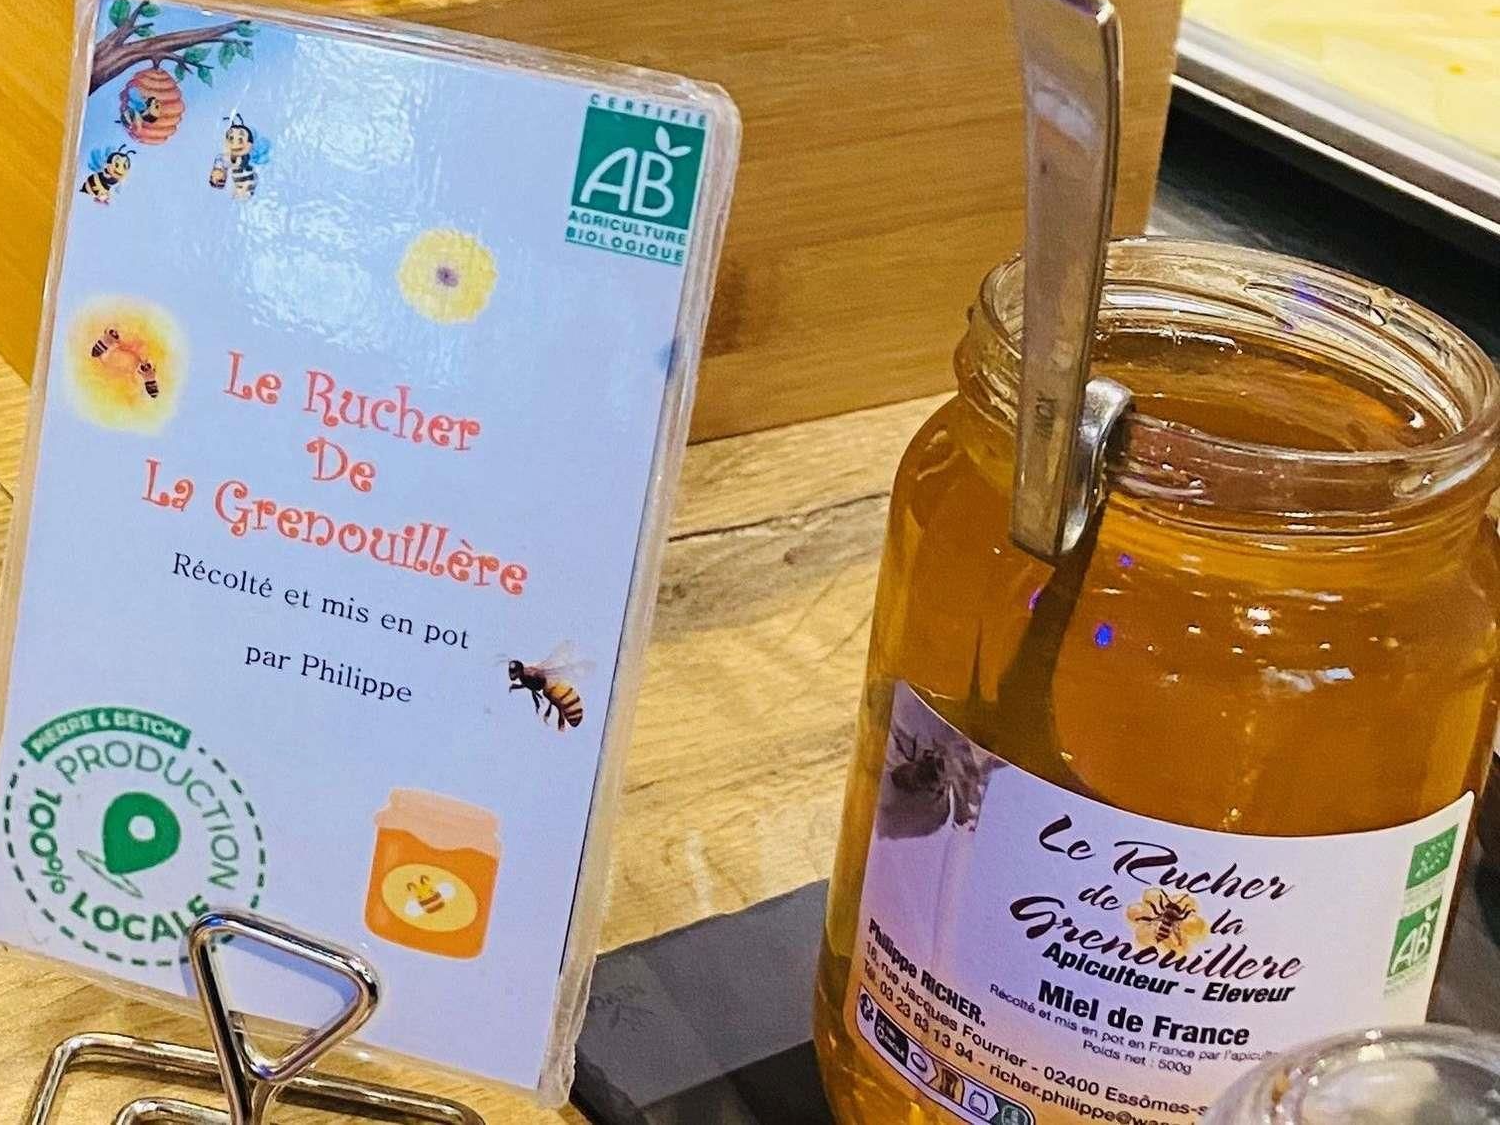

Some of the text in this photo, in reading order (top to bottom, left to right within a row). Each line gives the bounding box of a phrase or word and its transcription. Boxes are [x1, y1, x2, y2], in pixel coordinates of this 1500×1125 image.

[579, 146, 675, 218] AB
[565, 227, 683, 262] BIOLOGIQUE
[567, 210, 687, 246] AGRICULTURE
[223, 350, 481, 451] Le Rucher
[306, 436, 377, 492] De
[141, 459, 528, 595] La Grenouillère
[172, 551, 470, 650] Récolté et mis en pot
[244, 645, 413, 703] par Philippe
[28, 788, 74, 894] 100%
[54, 740, 240, 890] PRODUCTION
[1038, 814, 1294, 901] Le Rucher
[1078, 884, 1246, 937] de la
[868, 917, 987, 1027] Philippe RICHER.
[1041, 941, 1180, 997] Apiculteur
[1201, 981, 1297, 1003] Eleveur
[1390, 921, 1431, 975] AB
[880, 980, 894, 1002] 03
[894, 996, 912, 1019] 23
[913, 1012, 930, 1034] 83
[932, 1029, 950, 1049] 13
[954, 1042, 975, 1064] 94
[881, 962, 899, 985] rue
[900, 979, 959, 1032] Jacques
[962, 1023, 1028, 1068] Fourrier
[1043, 1066, 1100, 1096] 02400
[1104, 1086, 1209, 1117] Essômes-s
[1038, 979, 1251, 1047] Miel de France
[1038, 1008, 1051, 1021] et
[1054, 1016, 1078, 1032] mis
[1081, 1025, 1098, 1038] en
[1100, 1031, 1125, 1046] pot
[1127, 1038, 1145, 1050] en
[1148, 1040, 1196, 1059] France
[1198, 1050, 1221, 1062] par
[1082, 1039, 1121, 1061] Poids
[1124, 1053, 1147, 1067] net
[1157, 1058, 1192, 1076] 500g
